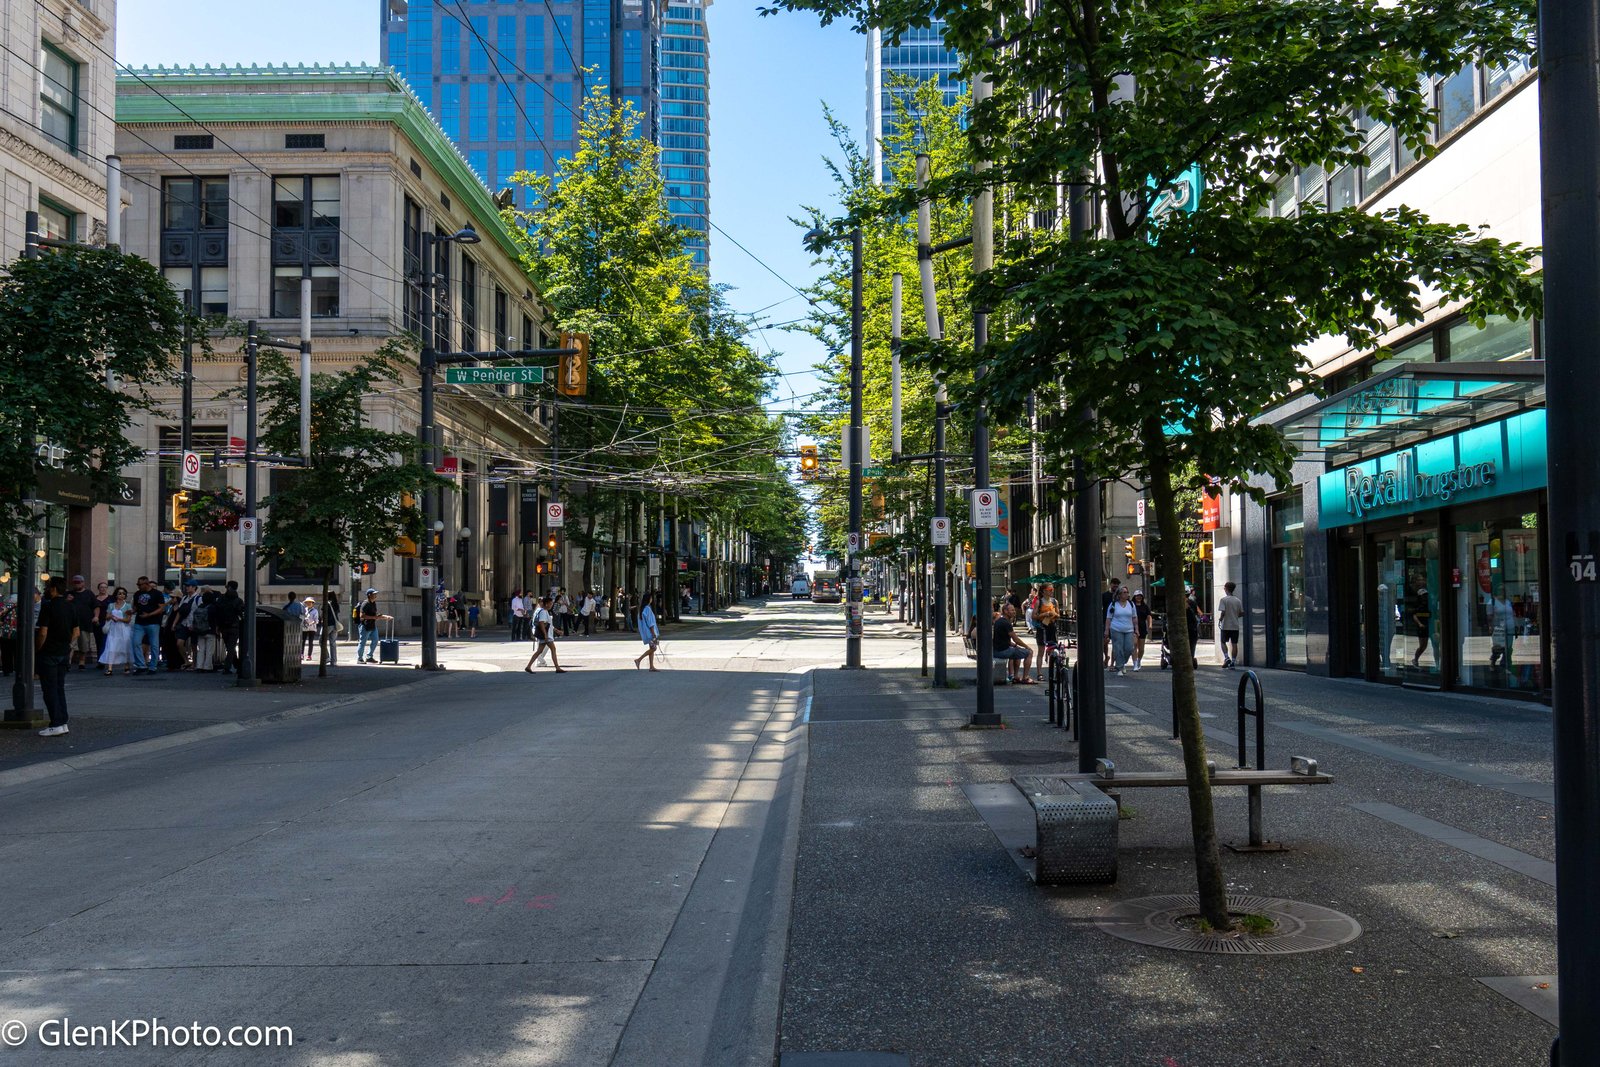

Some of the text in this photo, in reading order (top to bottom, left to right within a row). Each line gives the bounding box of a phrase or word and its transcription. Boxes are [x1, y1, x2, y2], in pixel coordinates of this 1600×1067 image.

[456, 369, 532, 381] W Pender St
[1346, 451, 1495, 517] Rexall Drugstore
[1570, 561, 1597, 582] 04
